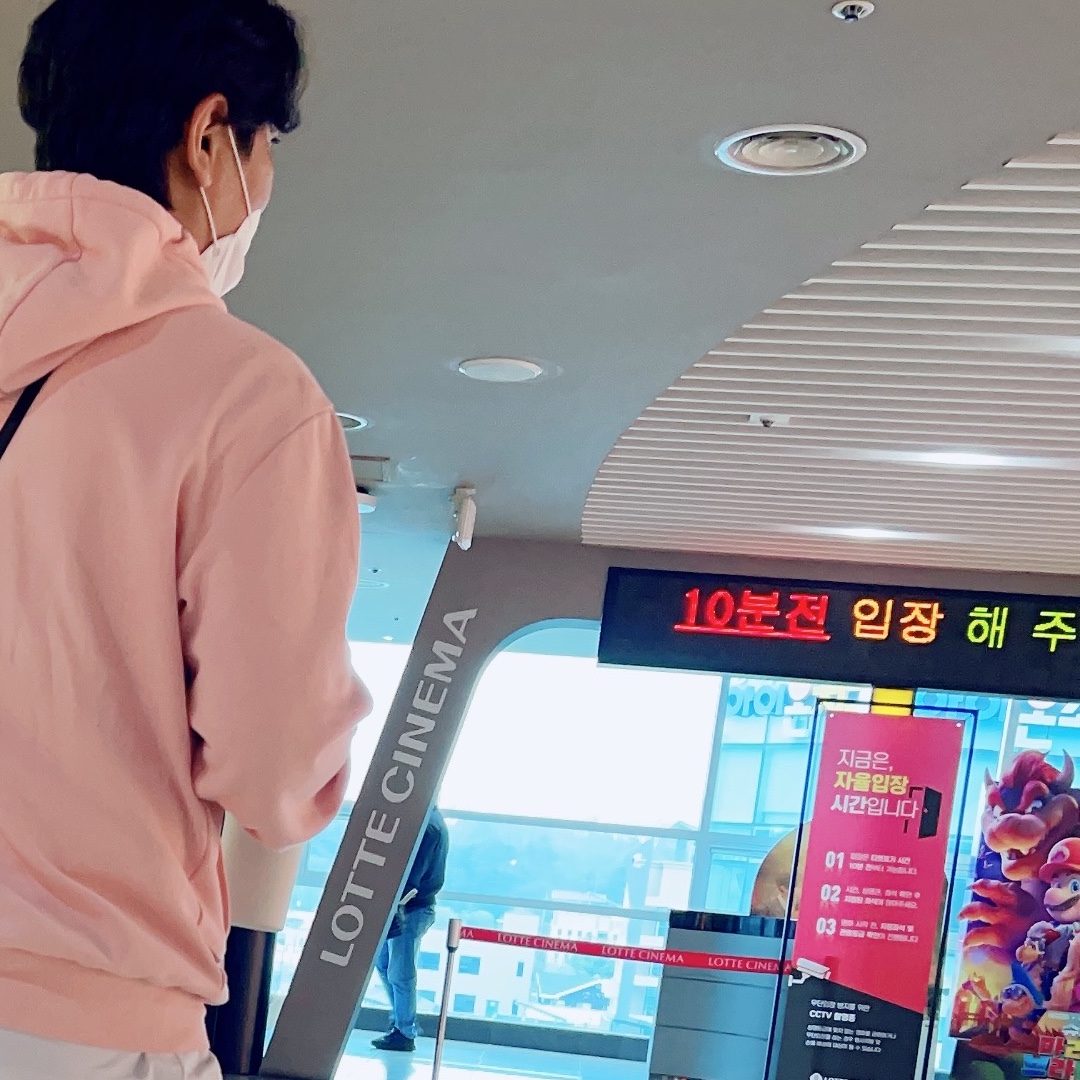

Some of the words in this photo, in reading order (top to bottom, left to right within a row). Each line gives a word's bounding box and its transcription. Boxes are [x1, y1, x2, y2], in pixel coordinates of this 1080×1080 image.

[683, 589, 831, 637] 10분전
[853, 598, 944, 645] 입장
[966, 606, 1009, 649] 해
[1032, 610, 1077, 652] 주
[837, 749, 894, 771] 지금은,
[320, 809, 400, 967] LOTTE
[380, 608, 478, 803] CINEMA
[834, 771, 910, 795] 자율입장
[830, 794, 919, 819] 시간입니다
[825, 851, 845, 869] 01
[820, 884, 842, 903] 02
[816, 917, 837, 936] 03
[497, 931, 532, 946] LOTTE
[533, 938, 578, 952] CINEMA
[602, 945, 636, 958] LOTTE
[639, 949, 684, 963] CINEMA
[708, 957, 743, 969] LOTTE
[809, 1009, 832, 1019] CCTV
